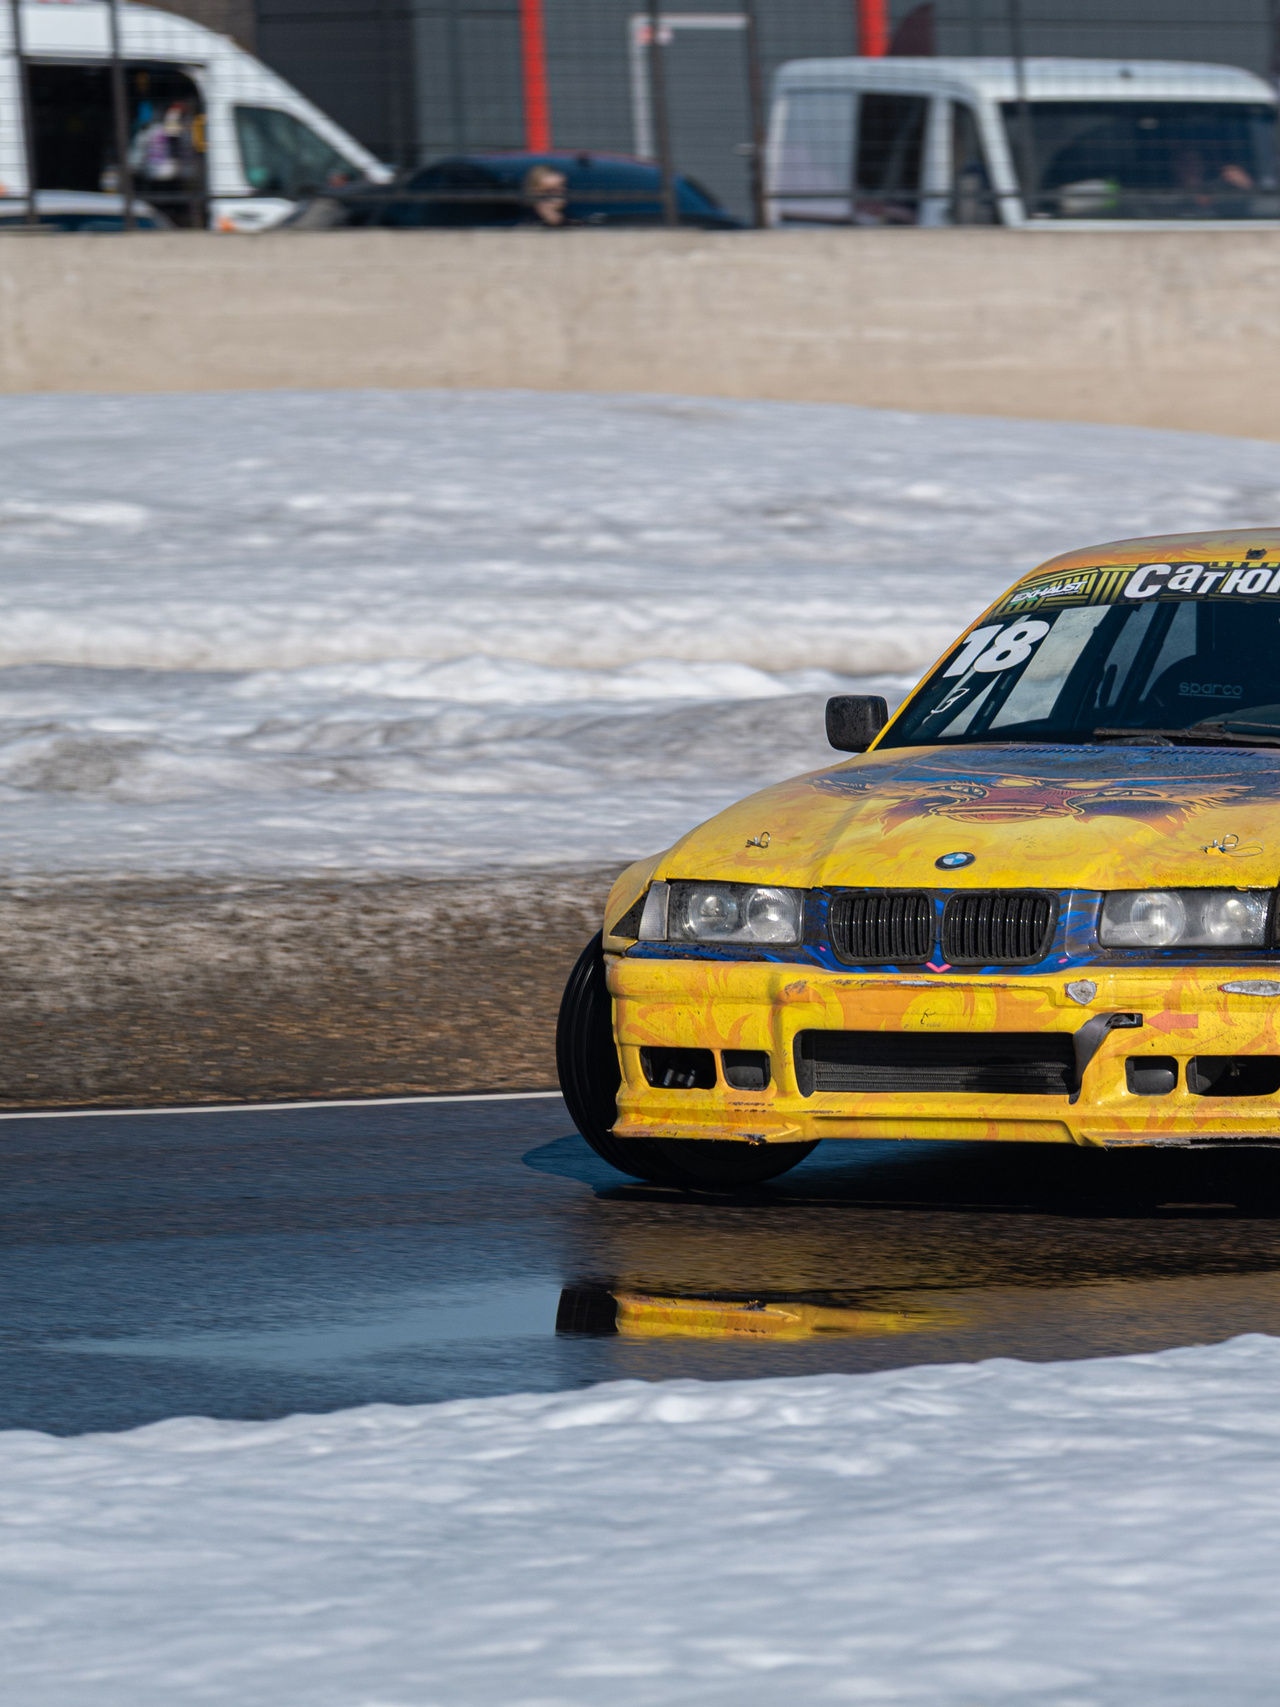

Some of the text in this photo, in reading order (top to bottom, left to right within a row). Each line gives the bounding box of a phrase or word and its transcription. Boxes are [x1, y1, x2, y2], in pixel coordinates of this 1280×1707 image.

[1010, 580, 1088, 603] EXHAUST
[942, 619, 1050, 678] 18
[1179, 681, 1242, 698] sparco
